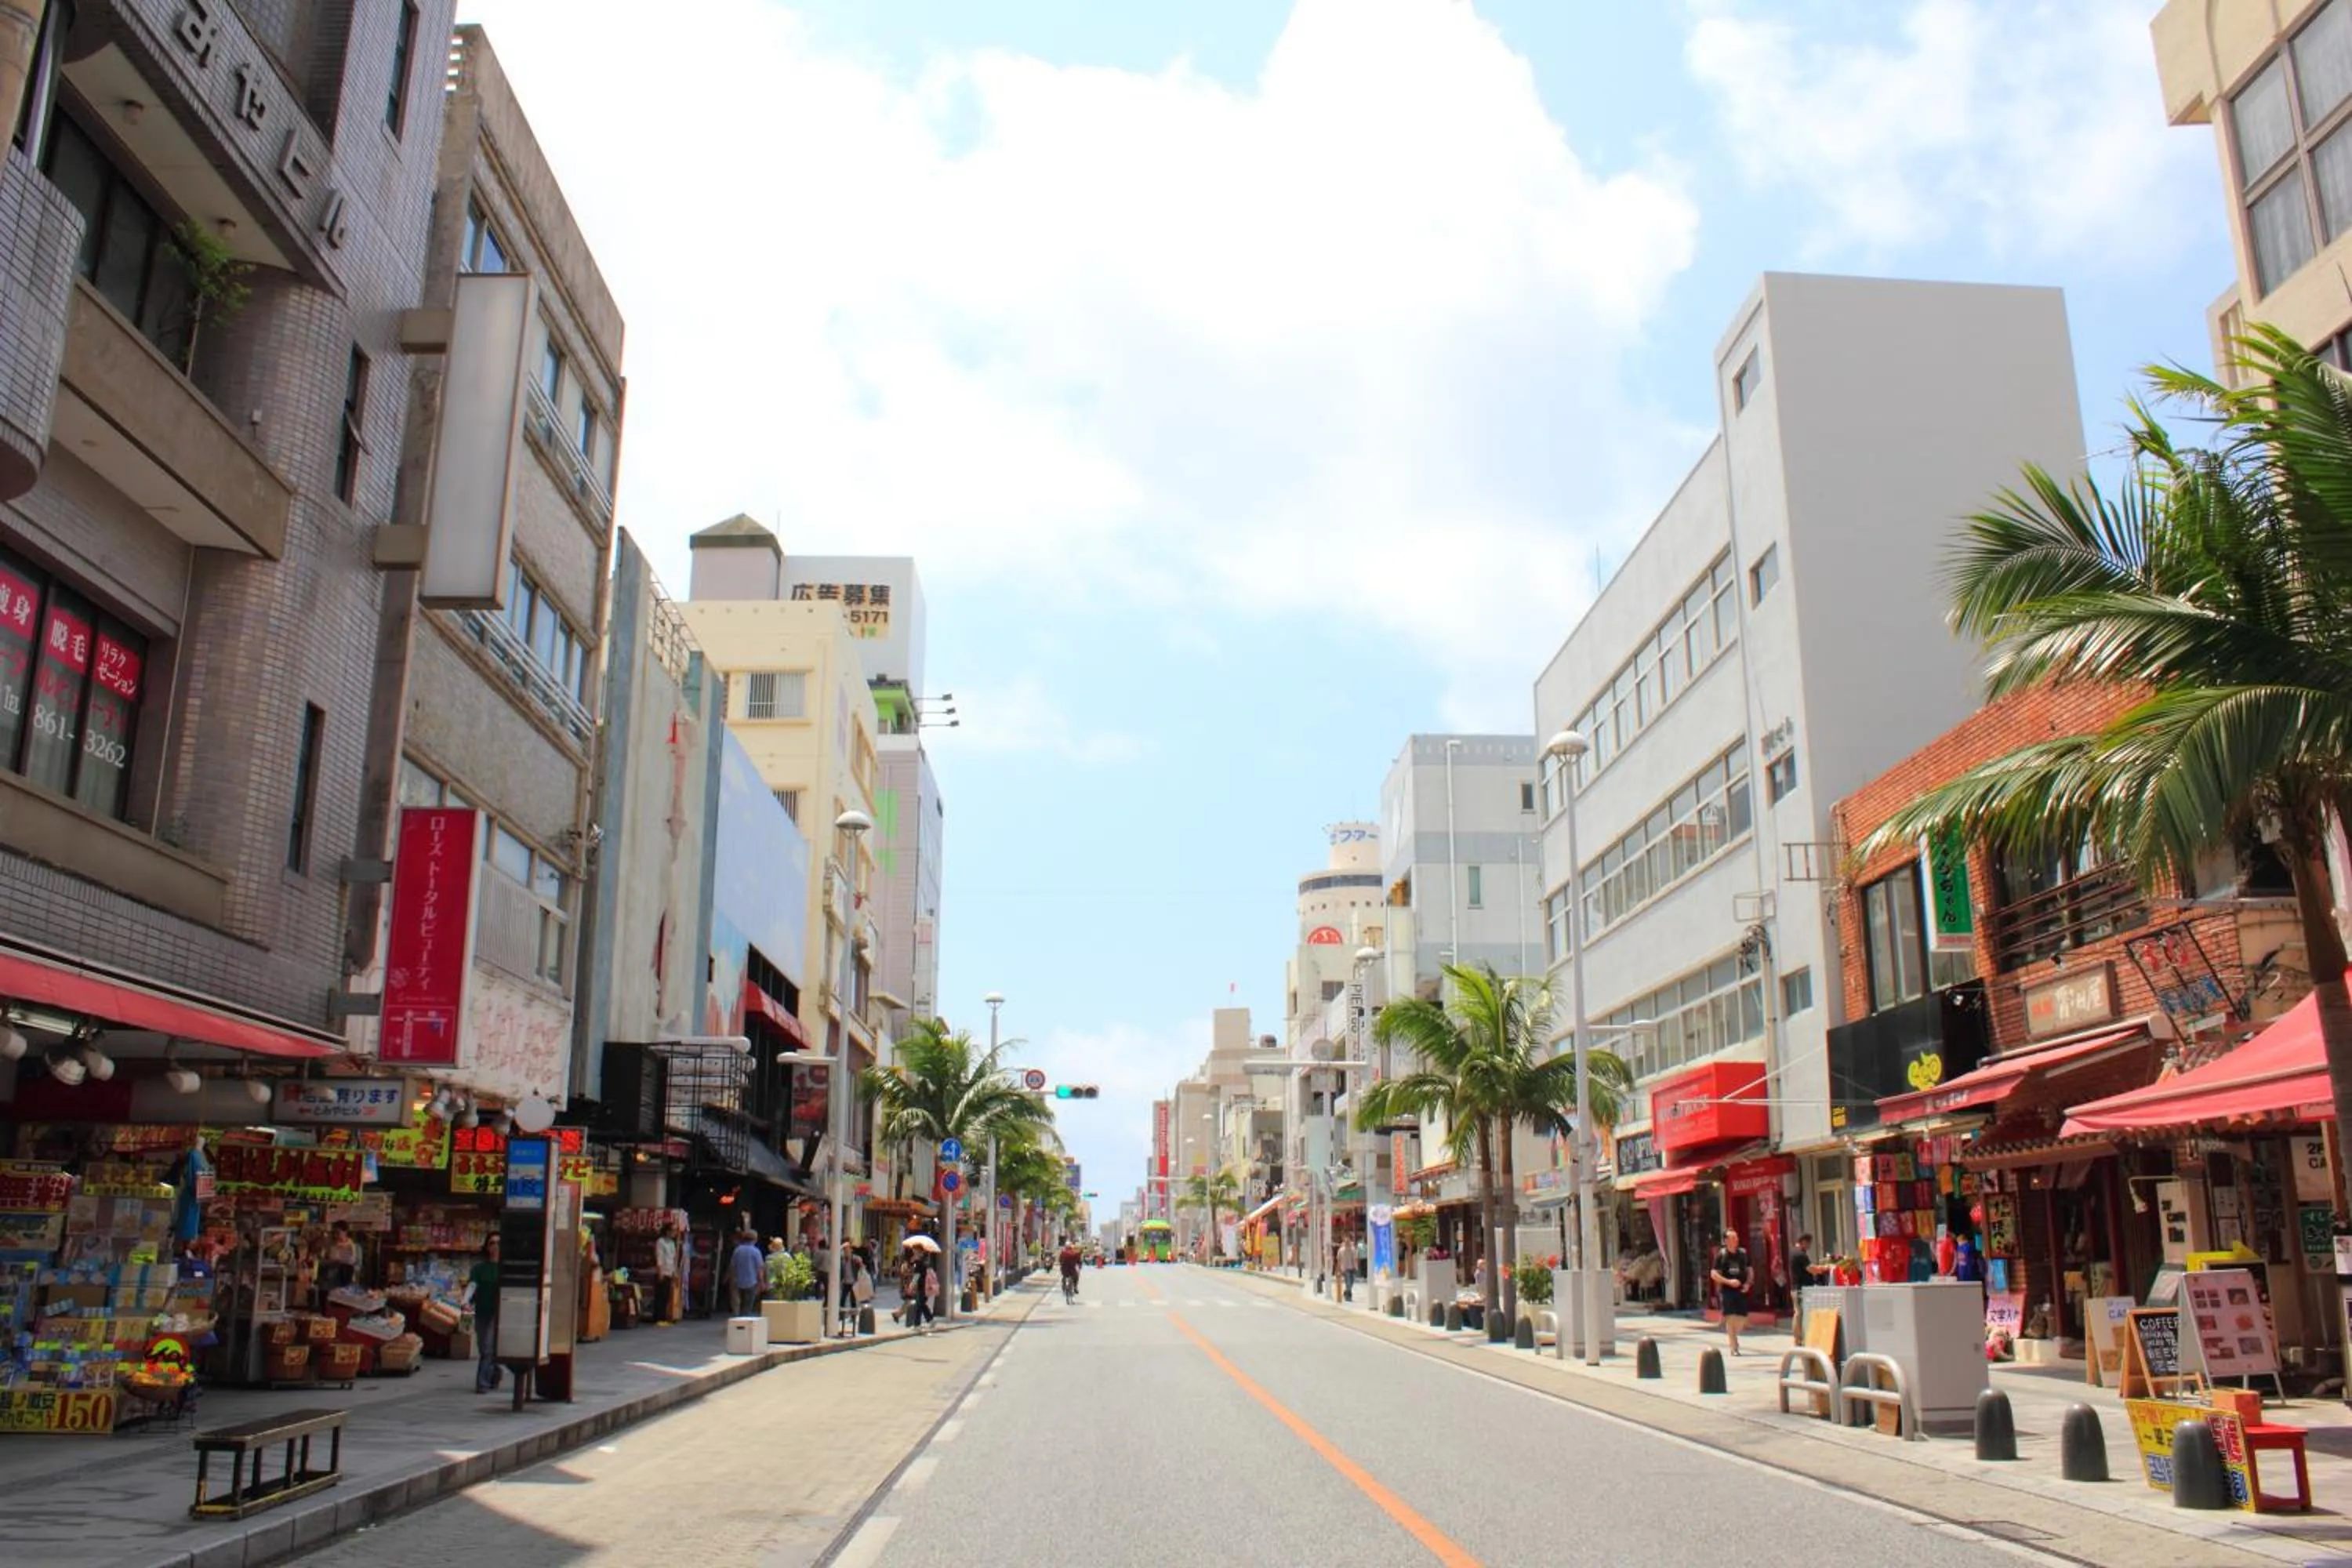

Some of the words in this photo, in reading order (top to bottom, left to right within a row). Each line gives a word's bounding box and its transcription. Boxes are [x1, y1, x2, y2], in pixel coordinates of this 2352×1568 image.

[50, 619, 86, 663] 脱毛
[101, 641, 126, 668] リラク
[97, 663, 136, 695] ゼーション
